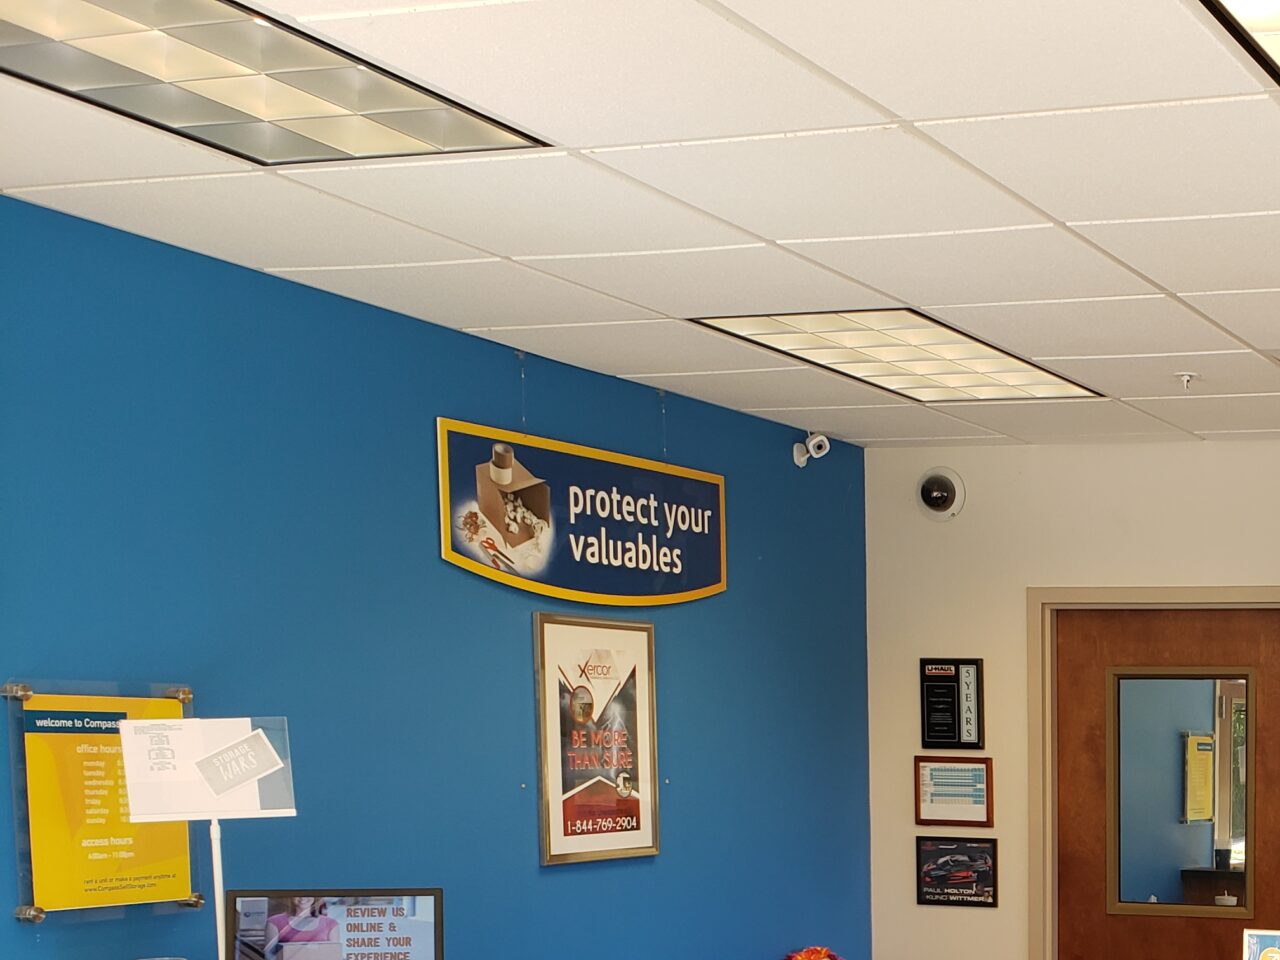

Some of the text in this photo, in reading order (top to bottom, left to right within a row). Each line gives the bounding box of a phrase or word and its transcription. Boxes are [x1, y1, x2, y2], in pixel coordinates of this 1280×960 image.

[568, 485, 712, 539] protect your
[568, 526, 683, 574] valuables
[965, 669, 971, 678] 5
[35, 718, 73, 728] welcome
[74, 718, 83, 728] to
[571, 729, 628, 748] BE MORE
[99, 744, 122, 753] hour
[212, 743, 251, 766] STORAGE
[567, 751, 633, 770] THAN SURE
[567, 817, 637, 834] 1-844-769-2904
[346, 907, 405, 918] REVIEW US
[346, 922, 396, 933] ONLINE &
[346, 936, 411, 948] SHARE YOUR
